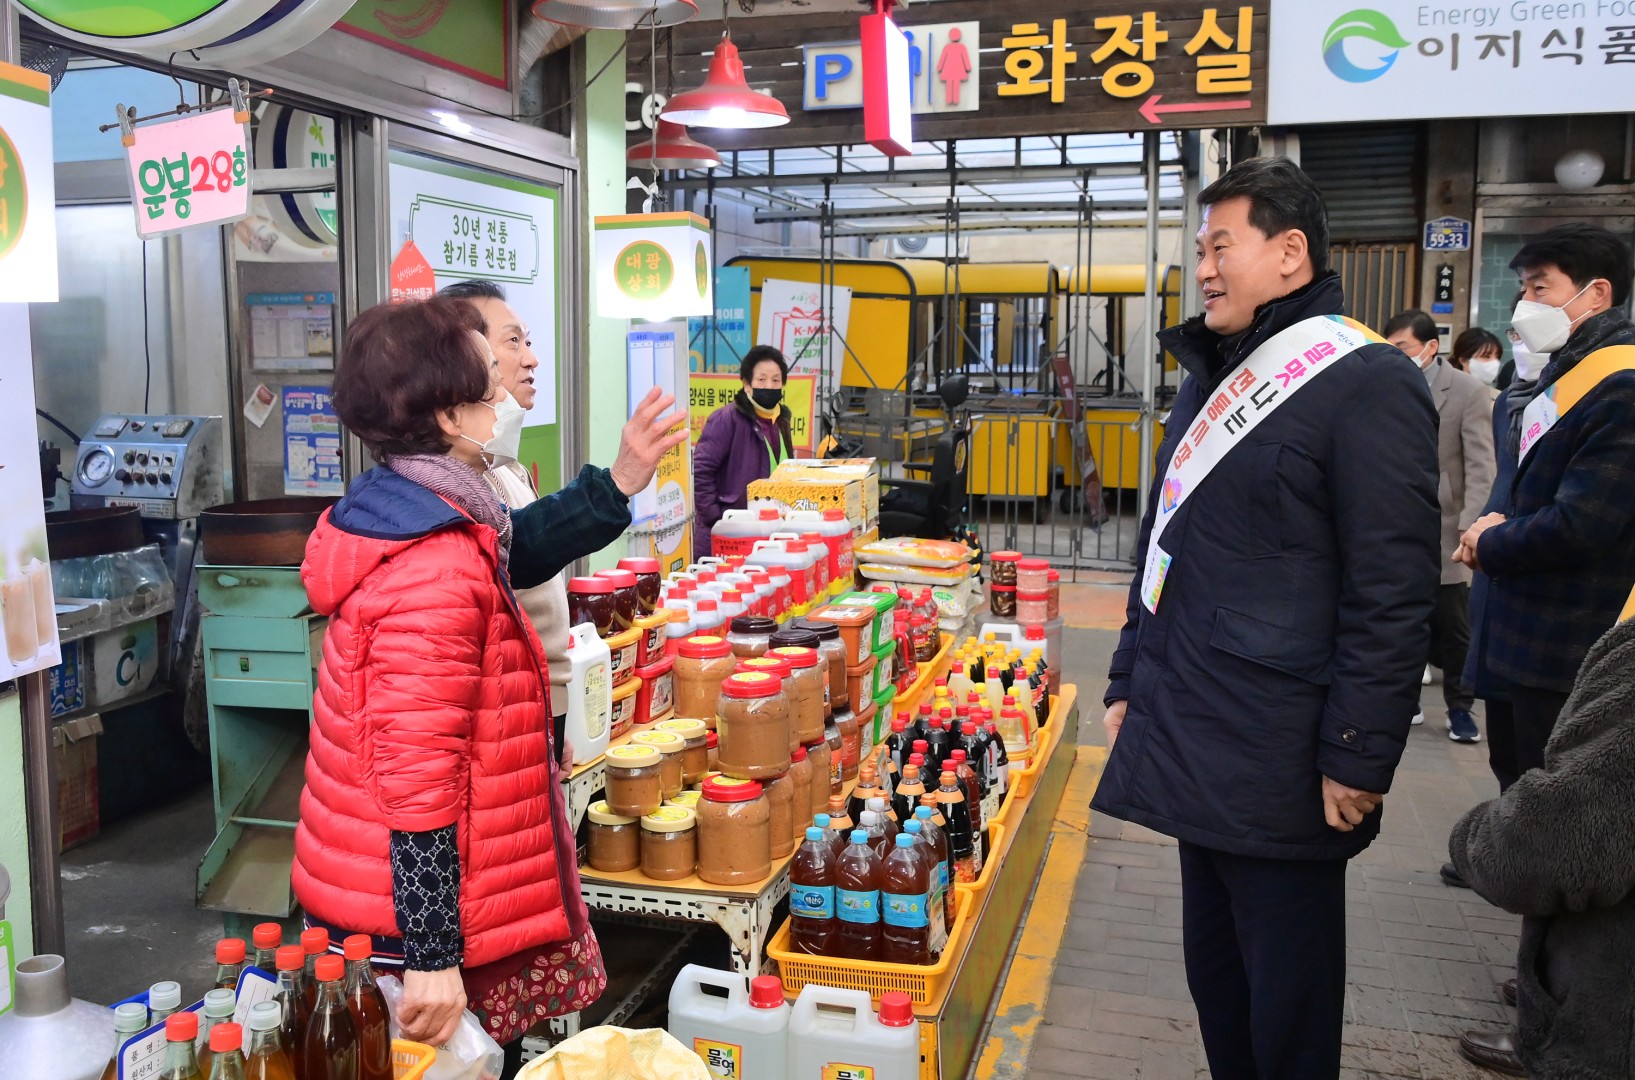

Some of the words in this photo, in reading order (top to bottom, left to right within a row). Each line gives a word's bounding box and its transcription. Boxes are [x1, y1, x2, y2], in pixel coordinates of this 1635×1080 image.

[1417, 5, 1500, 27] Energy
[1511, 0, 1585, 22] Green
[997, 6, 1254, 103] 화장실
[1417, 26, 1635, 71] 이지식품
[815, 54, 853, 100] P
[138, 145, 248, 220] 운봉28호
[453, 214, 481, 241] 30년
[487, 220, 508, 245] 전통
[1430, 232, 1464, 248] 59-33
[443, 239, 479, 268] 참기름
[485, 246, 516, 272] 전문점
[626, 251, 661, 270] 대광
[627, 272, 661, 292] 상회
[706, 1048, 736, 1078] 물엿
